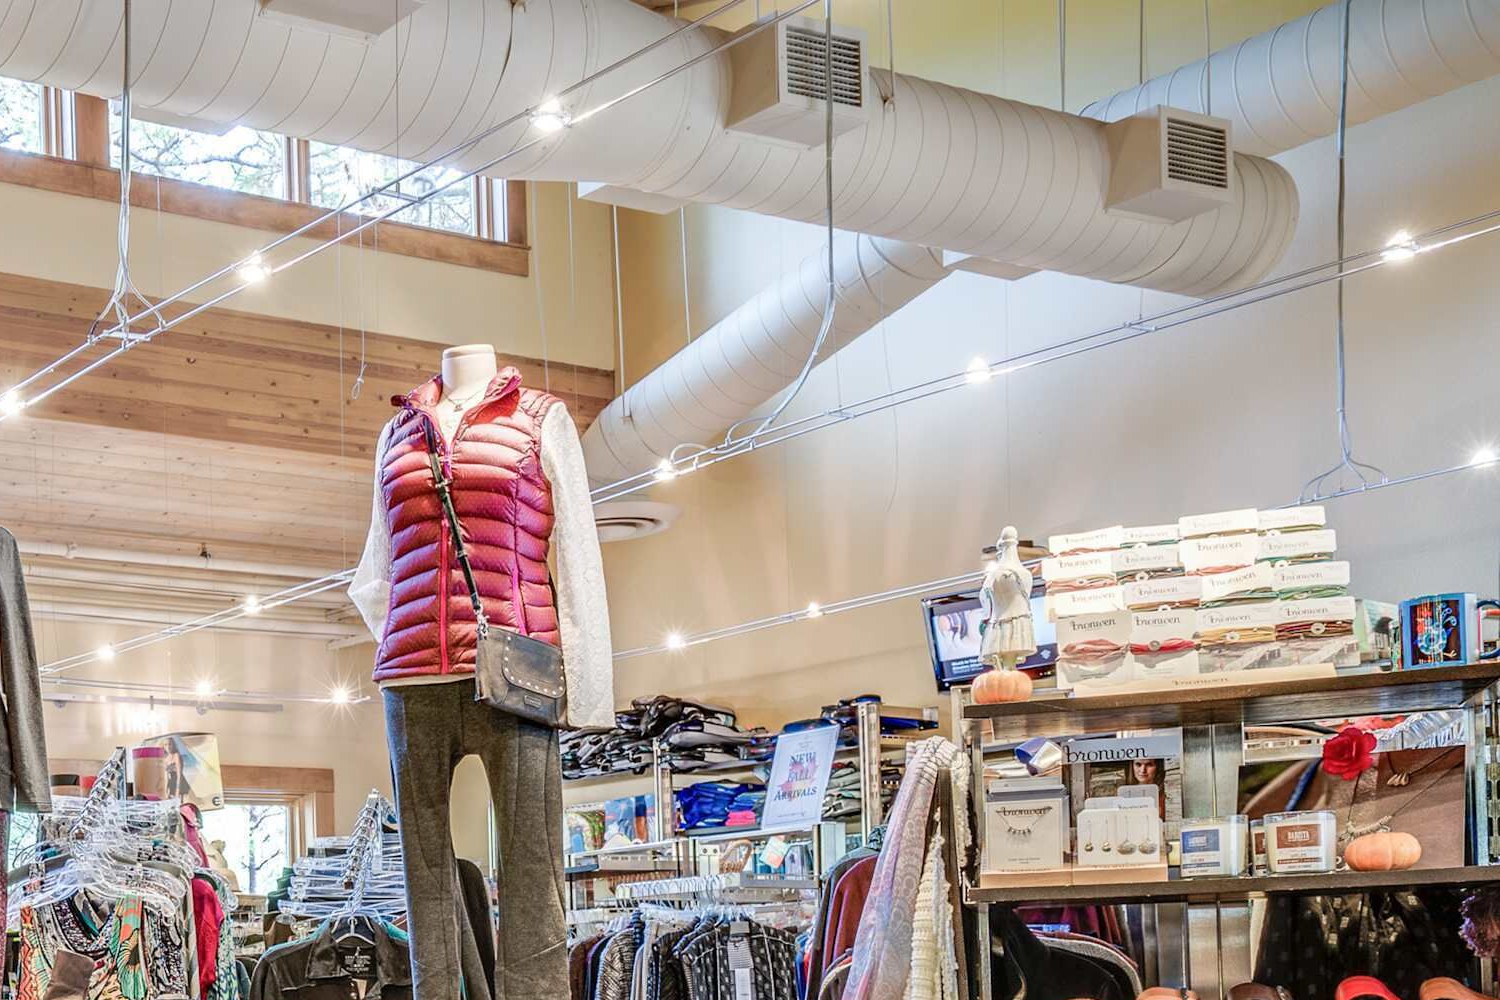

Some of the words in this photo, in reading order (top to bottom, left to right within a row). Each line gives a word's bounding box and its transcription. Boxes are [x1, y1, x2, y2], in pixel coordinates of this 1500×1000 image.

[1070, 616, 1116, 632] bronwen
[1134, 614, 1181, 627] bronwen
[790, 751, 817, 765] NEW
[1062, 744, 1148, 763] bronwen
[773, 785, 818, 802] ARRIVALS
